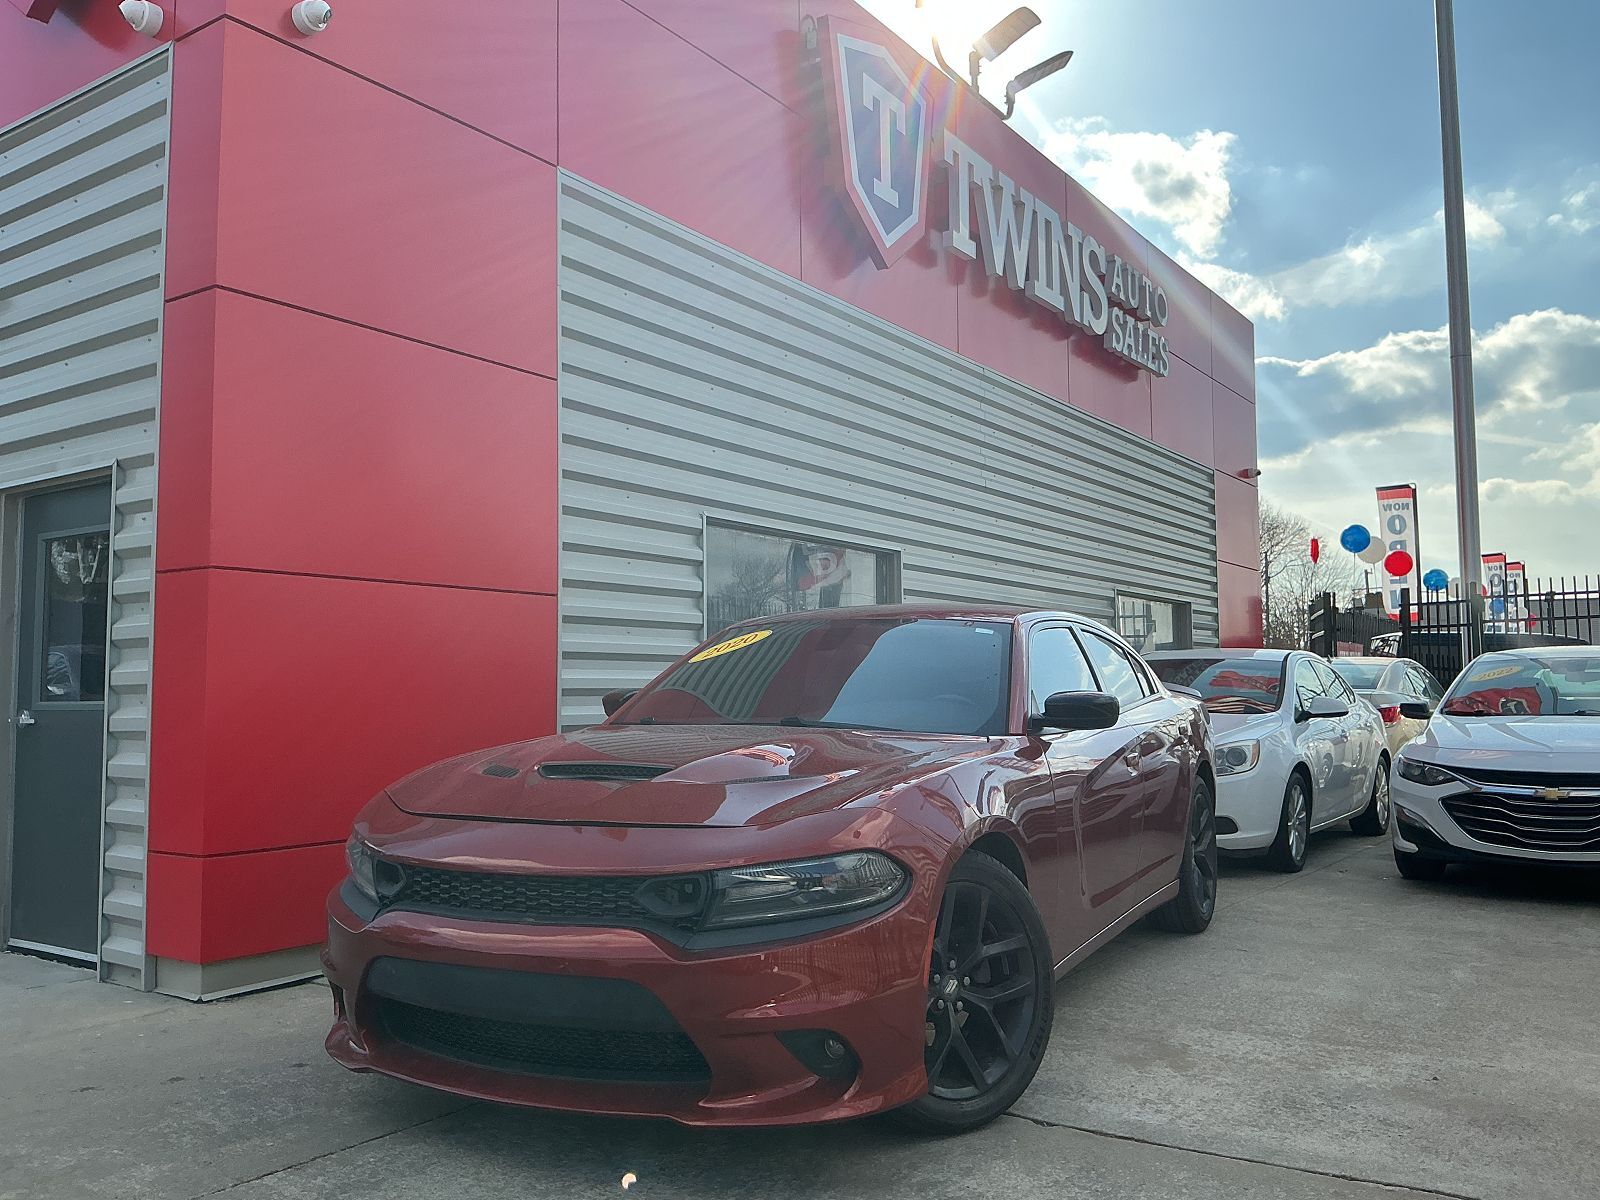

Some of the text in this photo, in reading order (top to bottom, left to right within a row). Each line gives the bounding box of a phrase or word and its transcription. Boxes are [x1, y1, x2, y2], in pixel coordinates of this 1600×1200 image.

[862, 71, 906, 209] T
[943, 129, 1108, 335] TWINS
[1110, 255, 1169, 328] AUTO
[1110, 306, 1170, 378] SALES
[703, 633, 759, 659] 2020
